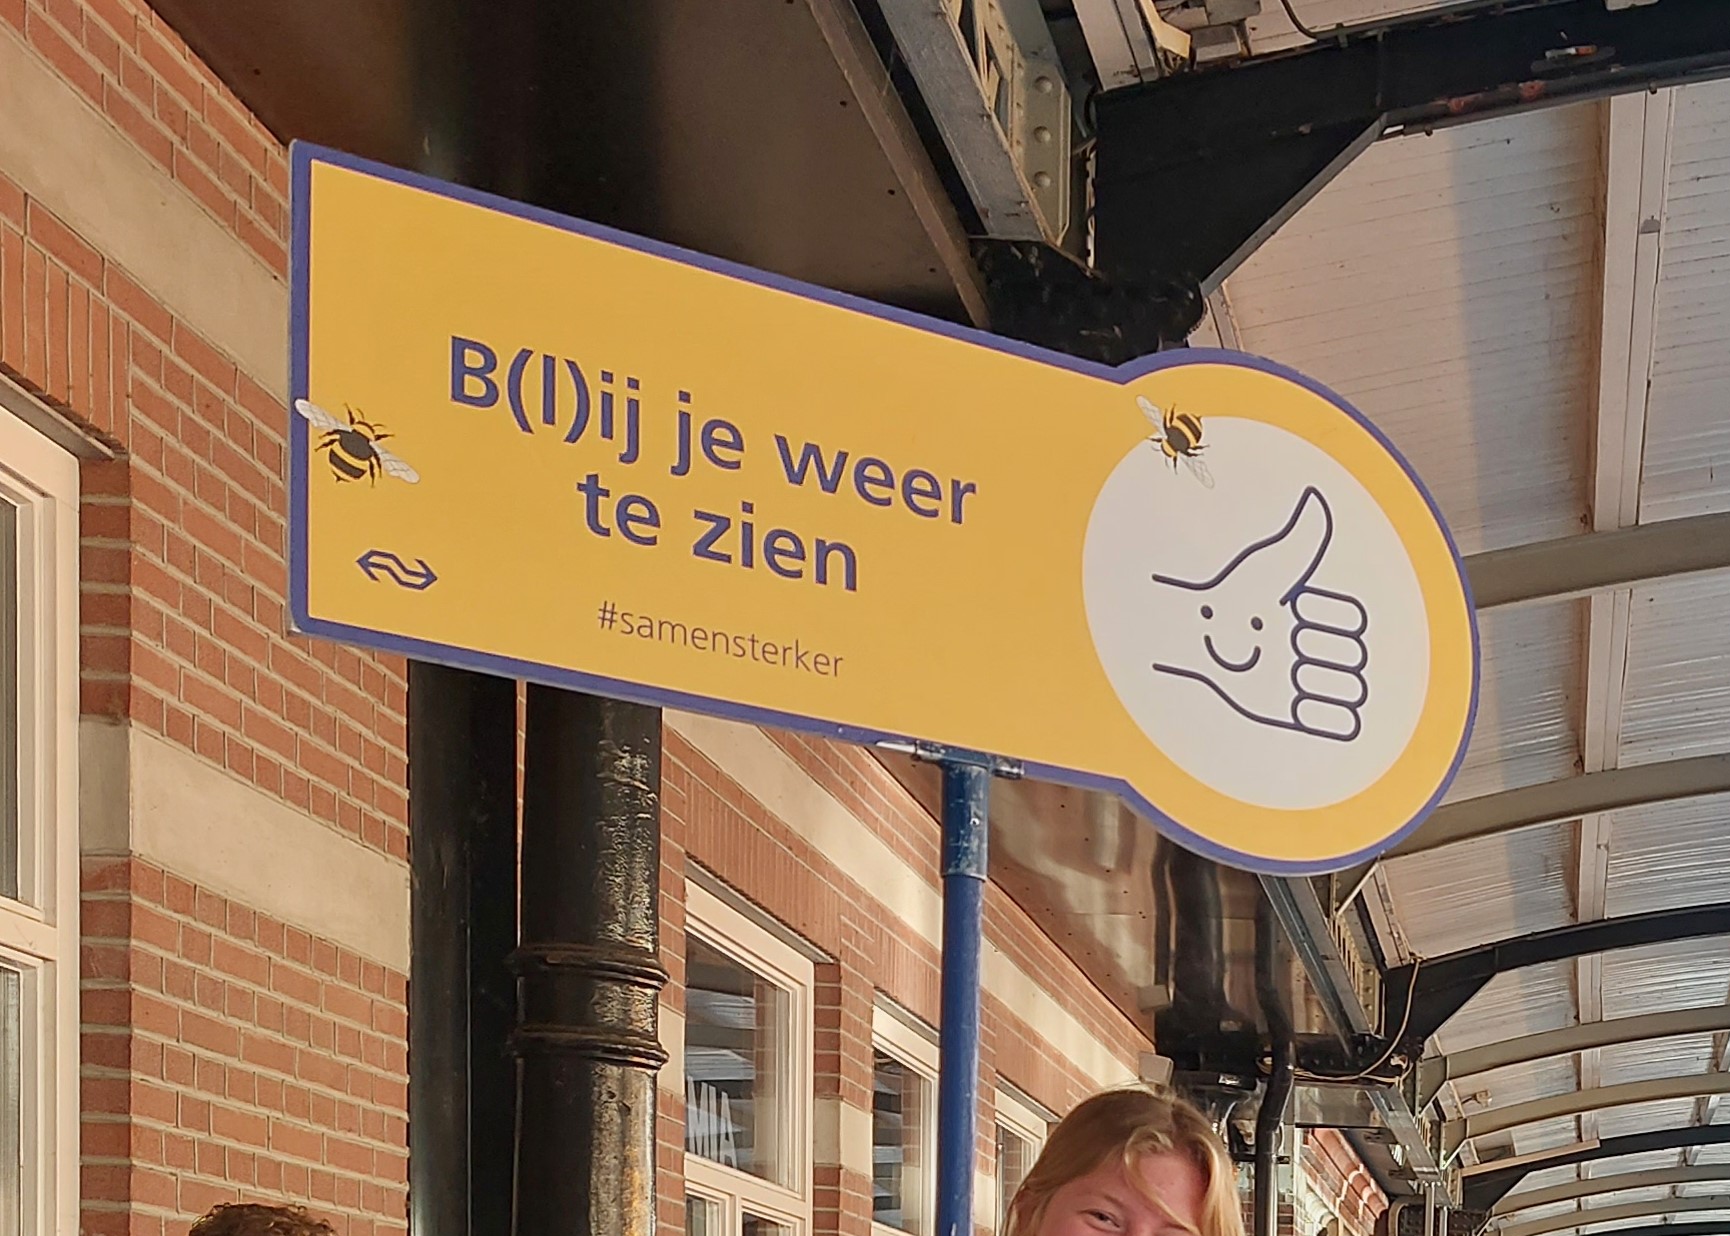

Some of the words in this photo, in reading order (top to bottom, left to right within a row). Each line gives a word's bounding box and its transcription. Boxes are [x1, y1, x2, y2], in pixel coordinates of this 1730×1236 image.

[450, 335, 640, 464] B(l)ij
[670, 389, 744, 476] je
[775, 433, 977, 524] weer
[576, 473, 661, 546] te
[692, 502, 858, 593] zien
[598, 600, 845, 678] #samensterker
